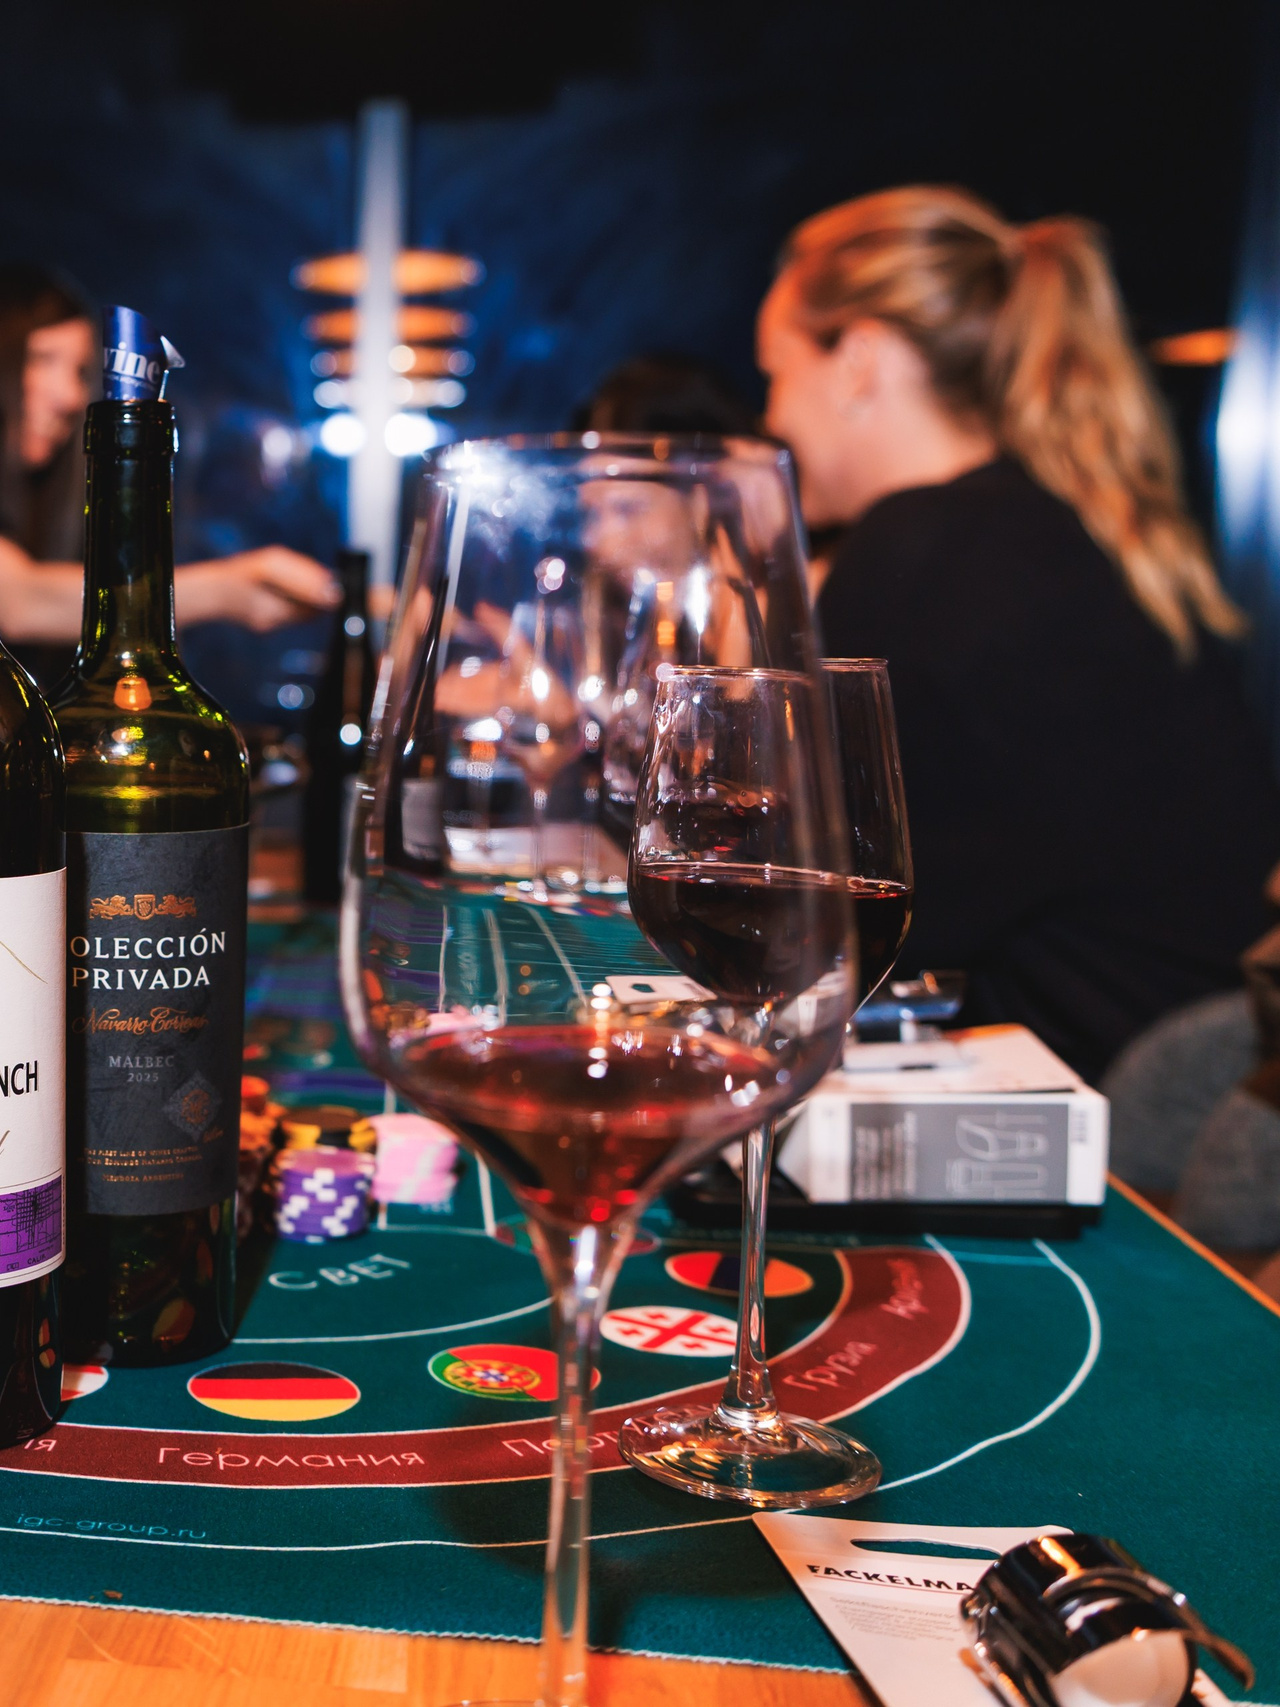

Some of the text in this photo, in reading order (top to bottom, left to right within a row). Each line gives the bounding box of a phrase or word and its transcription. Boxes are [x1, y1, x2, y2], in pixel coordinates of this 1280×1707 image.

[70, 927, 226, 959] OLECCIÓN
[72, 966, 210, 990] PRIVADA
[72, 1007, 150, 1036] Navarro
[108, 1055, 174, 1069] MALBEC
[158, 1447, 426, 1470] Германия
[17, 1513, 206, 1539] igc-group.ru
